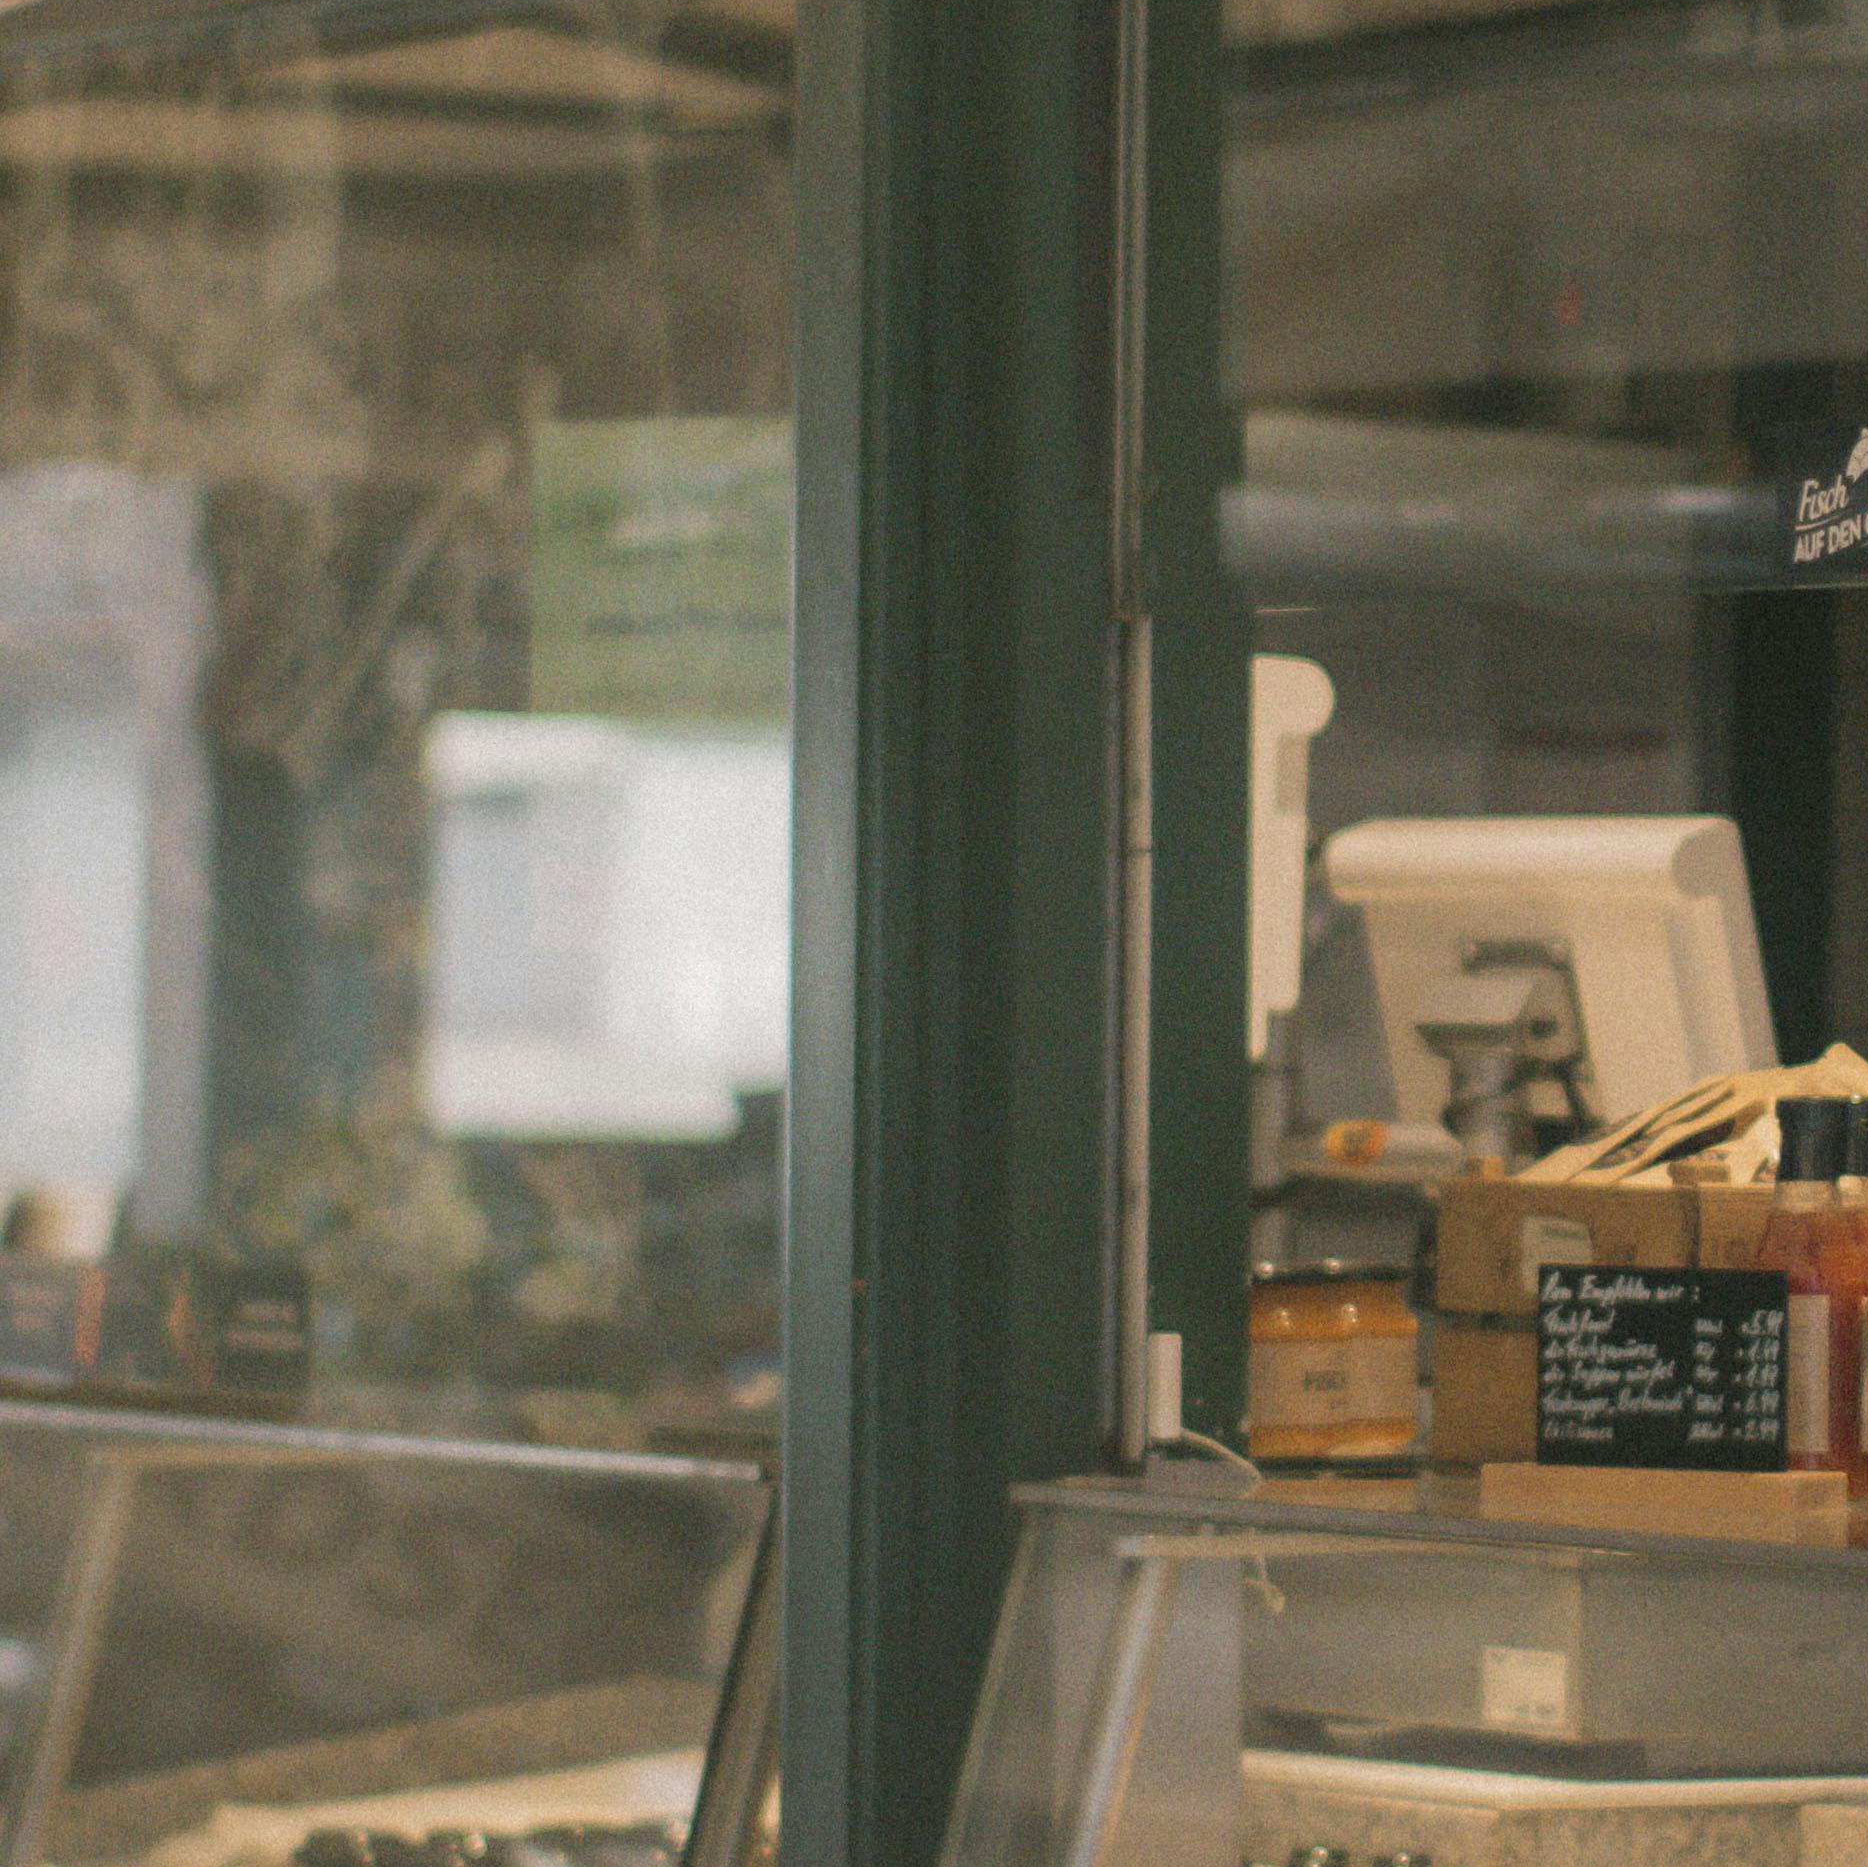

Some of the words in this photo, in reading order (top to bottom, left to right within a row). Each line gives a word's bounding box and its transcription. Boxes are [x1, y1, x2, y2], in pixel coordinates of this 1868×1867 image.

[1799, 477, 1847, 521] Fisch
[1795, 531, 1825, 563] AUF
[1828, 518, 1862, 552] DEN
